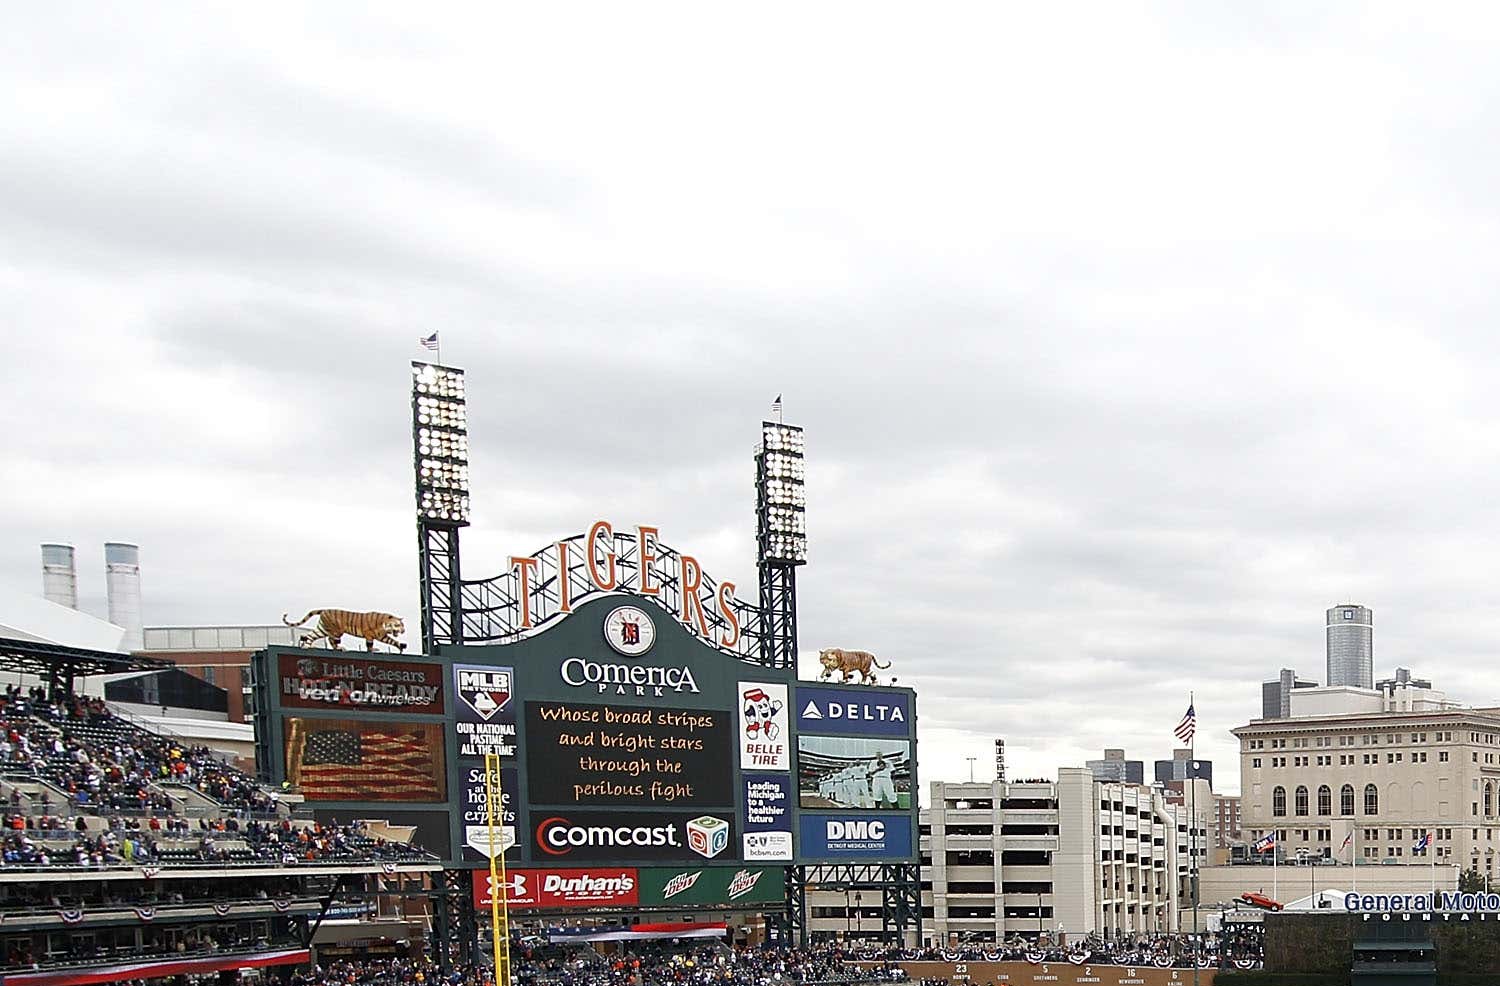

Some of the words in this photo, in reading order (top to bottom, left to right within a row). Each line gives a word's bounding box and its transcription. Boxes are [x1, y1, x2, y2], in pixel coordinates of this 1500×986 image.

[508, 521, 739, 647] TIGERS
[368, 666, 426, 683] Caesars
[460, 672, 508, 688] MLB
[598, 685, 664, 697] PARK
[829, 703, 905, 722] DELTA
[540, 707, 600, 723] Whose
[605, 707, 652, 724] broad
[657, 711, 714, 732] stripes
[457, 722, 475, 734] OUR
[477, 723, 516, 735] NATIONAL
[470, 734, 504, 745] PASTIME
[559, 732, 594, 746] and
[601, 731, 655, 752] bright
[660, 736, 703, 750] stars
[461, 744, 477, 755] ALL
[477, 744, 493, 755] THE
[494, 745, 515, 756] TIME
[746, 744, 783, 754] BELLE
[752, 755, 778, 765] TIRE
[579, 757, 650, 776] through
[656, 759, 682, 773] the
[474, 785, 484, 793] at
[573, 781, 644, 800] perilous
[649, 781, 694, 801] fight
[747, 781, 780, 792] Leading
[747, 790, 785, 800] Michigan
[748, 806, 785, 815] healthier
[748, 814, 774, 823] future
[826, 821, 885, 840] DMC
[544, 874, 634, 892] Dunham's
[1344, 892, 1435, 911] General
[955, 964, 967, 973] 23
[1042, 965, 1049, 973] 5
[1085, 967, 1091, 975] 2
[1127, 968, 1136, 977] 16
[1172, 971, 1178, 979] 6
